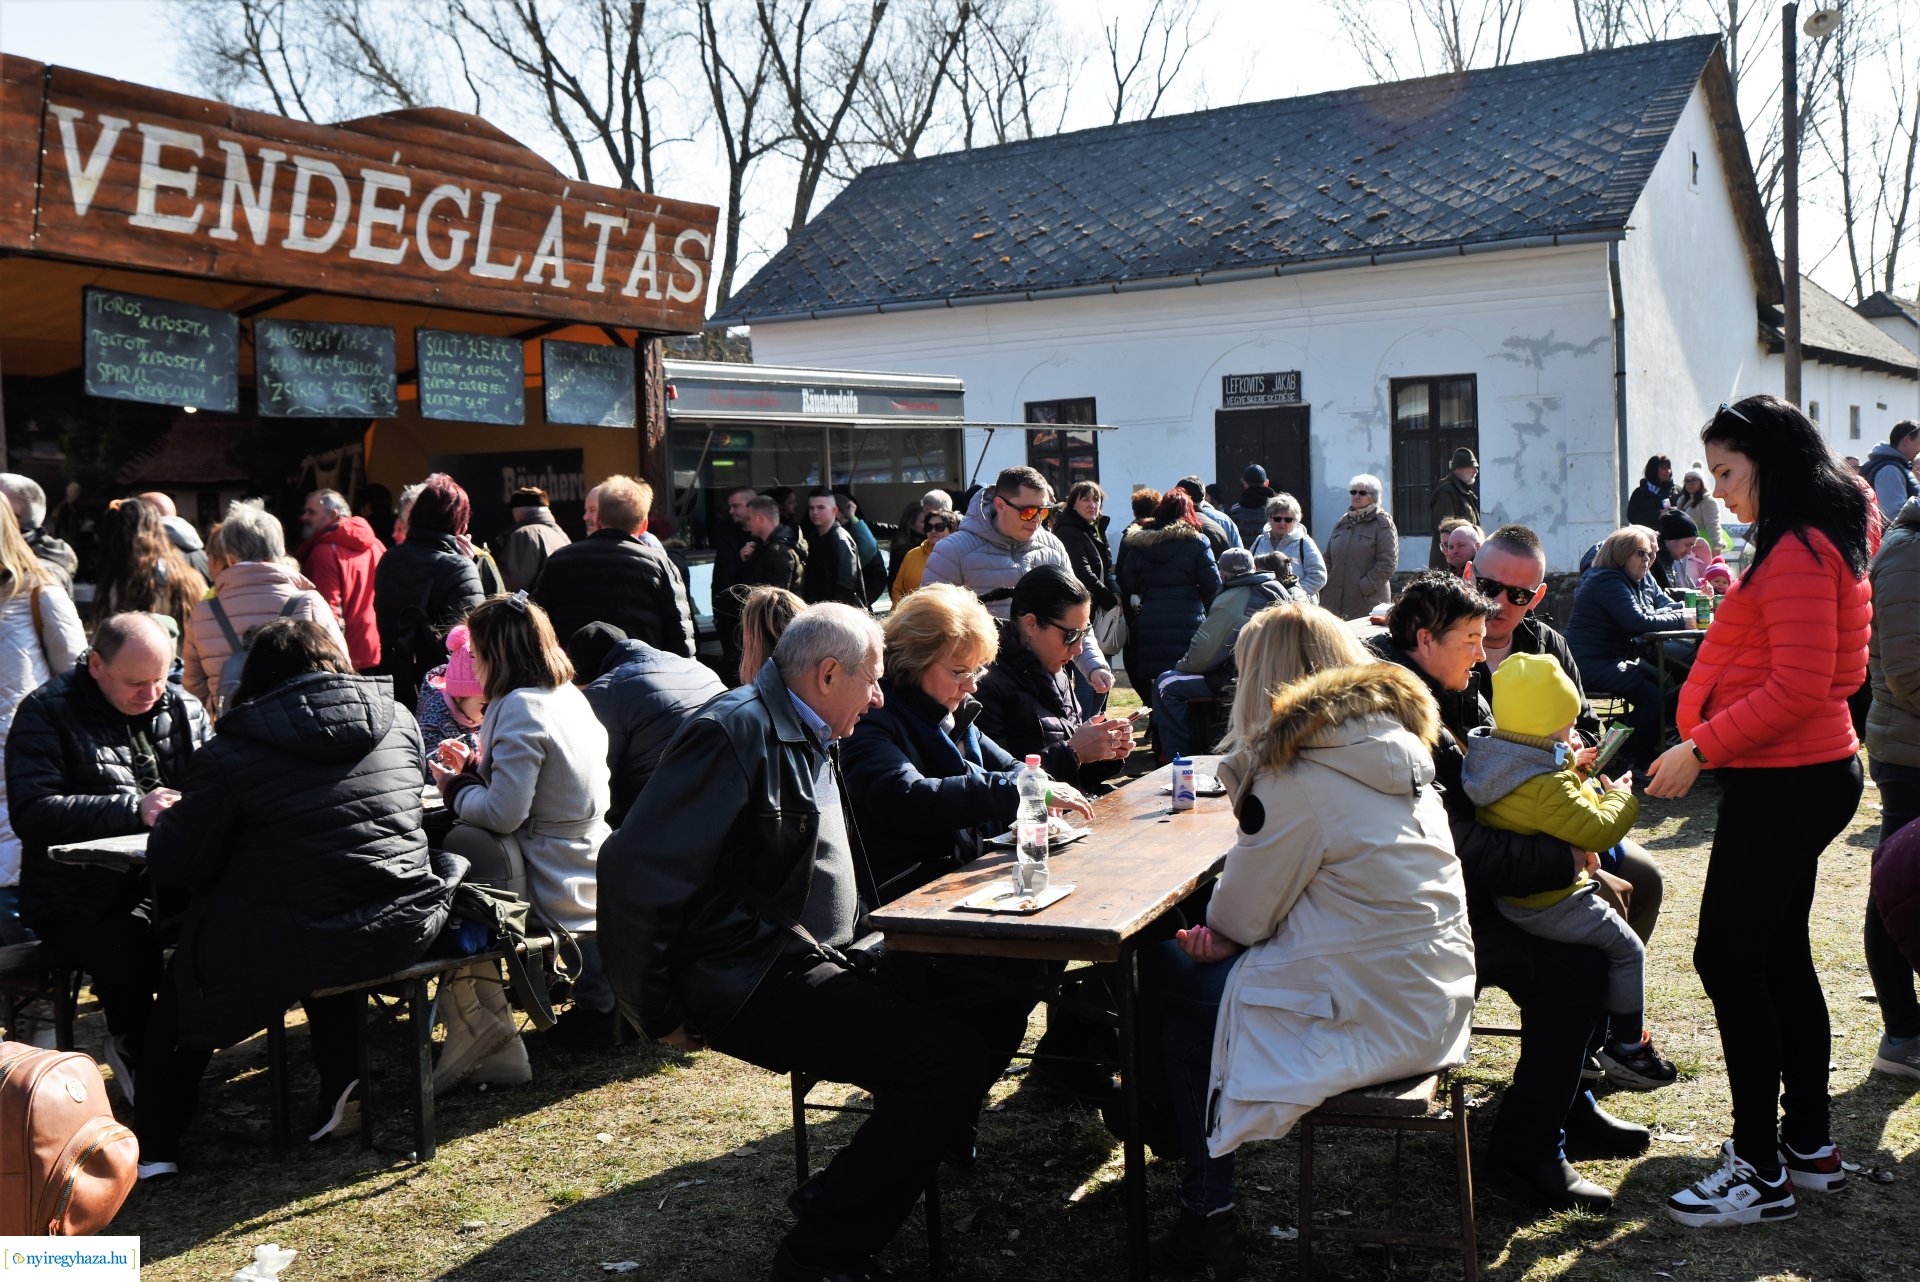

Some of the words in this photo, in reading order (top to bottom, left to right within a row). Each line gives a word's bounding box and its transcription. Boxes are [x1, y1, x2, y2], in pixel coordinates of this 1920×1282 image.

[48, 104, 712, 303] VENDÉGLÁTÁS
[1225, 376, 1265, 394] LEFKOVITS
[1272, 374, 1296, 392] JAKAB
